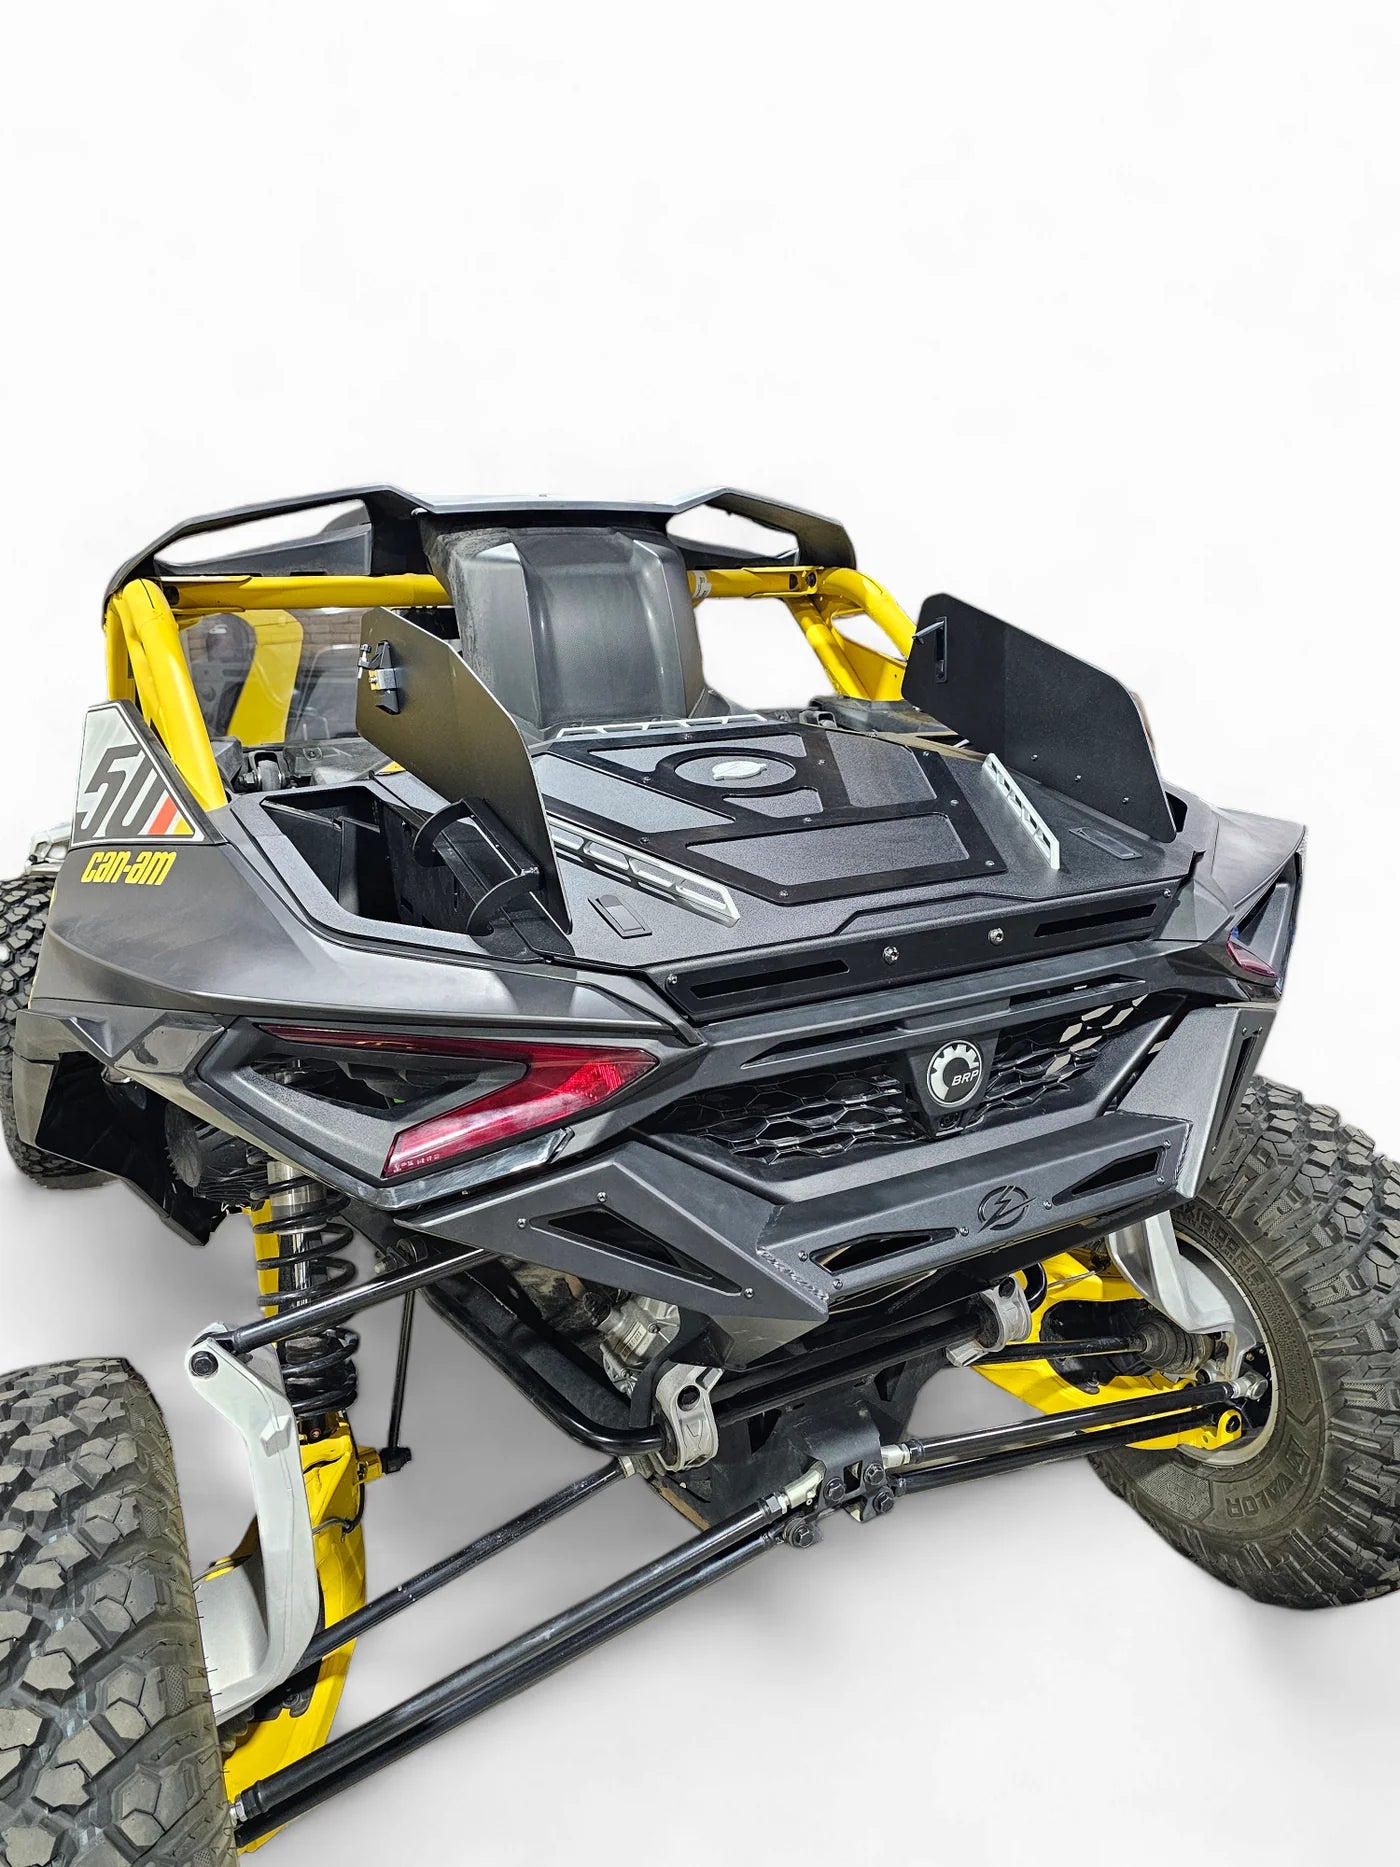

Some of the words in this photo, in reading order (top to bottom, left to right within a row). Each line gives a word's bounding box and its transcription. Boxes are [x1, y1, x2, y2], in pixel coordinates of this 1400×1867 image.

[74, 743, 160, 837] 50
[80, 850, 177, 886] can-am
[951, 1069, 980, 1087] BRP
[1225, 1472, 1295, 1518] VALOR
